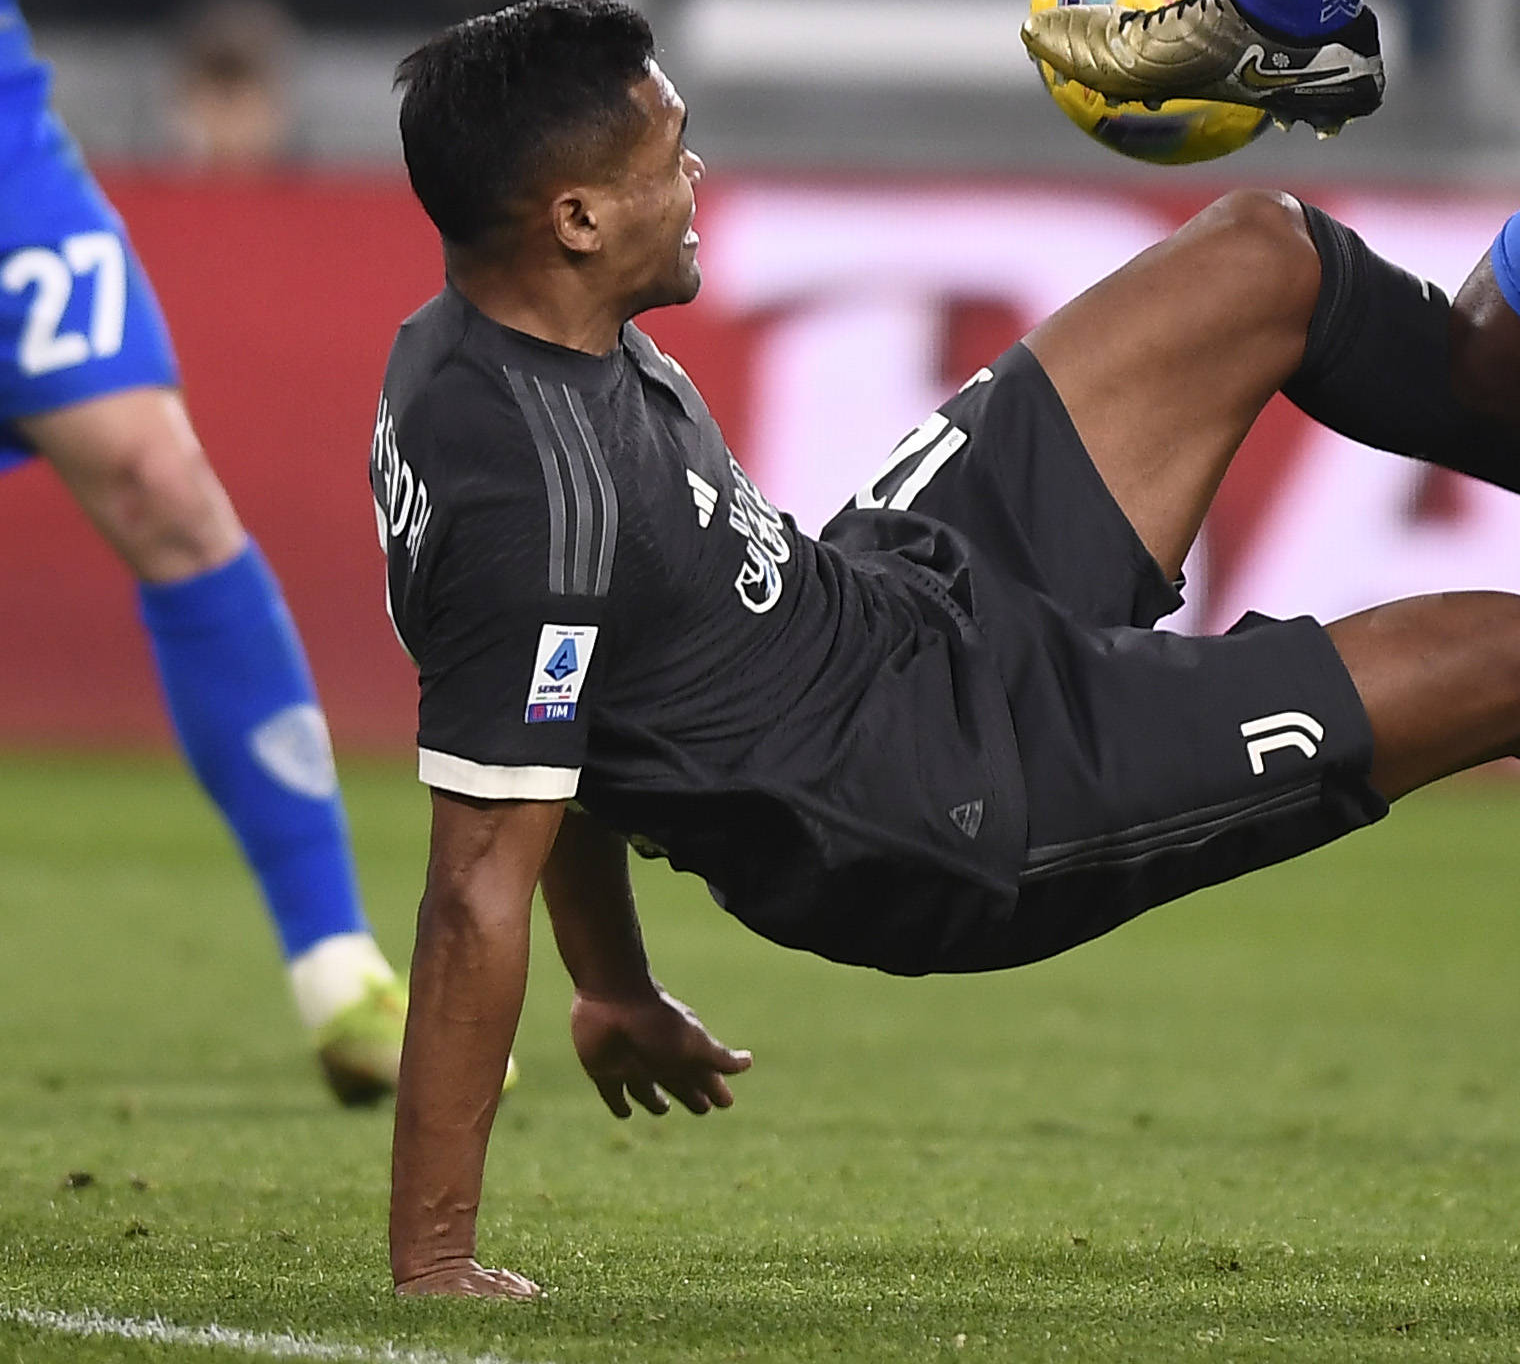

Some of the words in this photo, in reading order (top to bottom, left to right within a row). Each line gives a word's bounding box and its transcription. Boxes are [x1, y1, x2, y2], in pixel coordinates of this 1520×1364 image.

[1, 233, 127, 375] 27
[537, 684, 564, 694] SERIE
[565, 684, 572, 693] A
[546, 704, 569, 719] TIM
